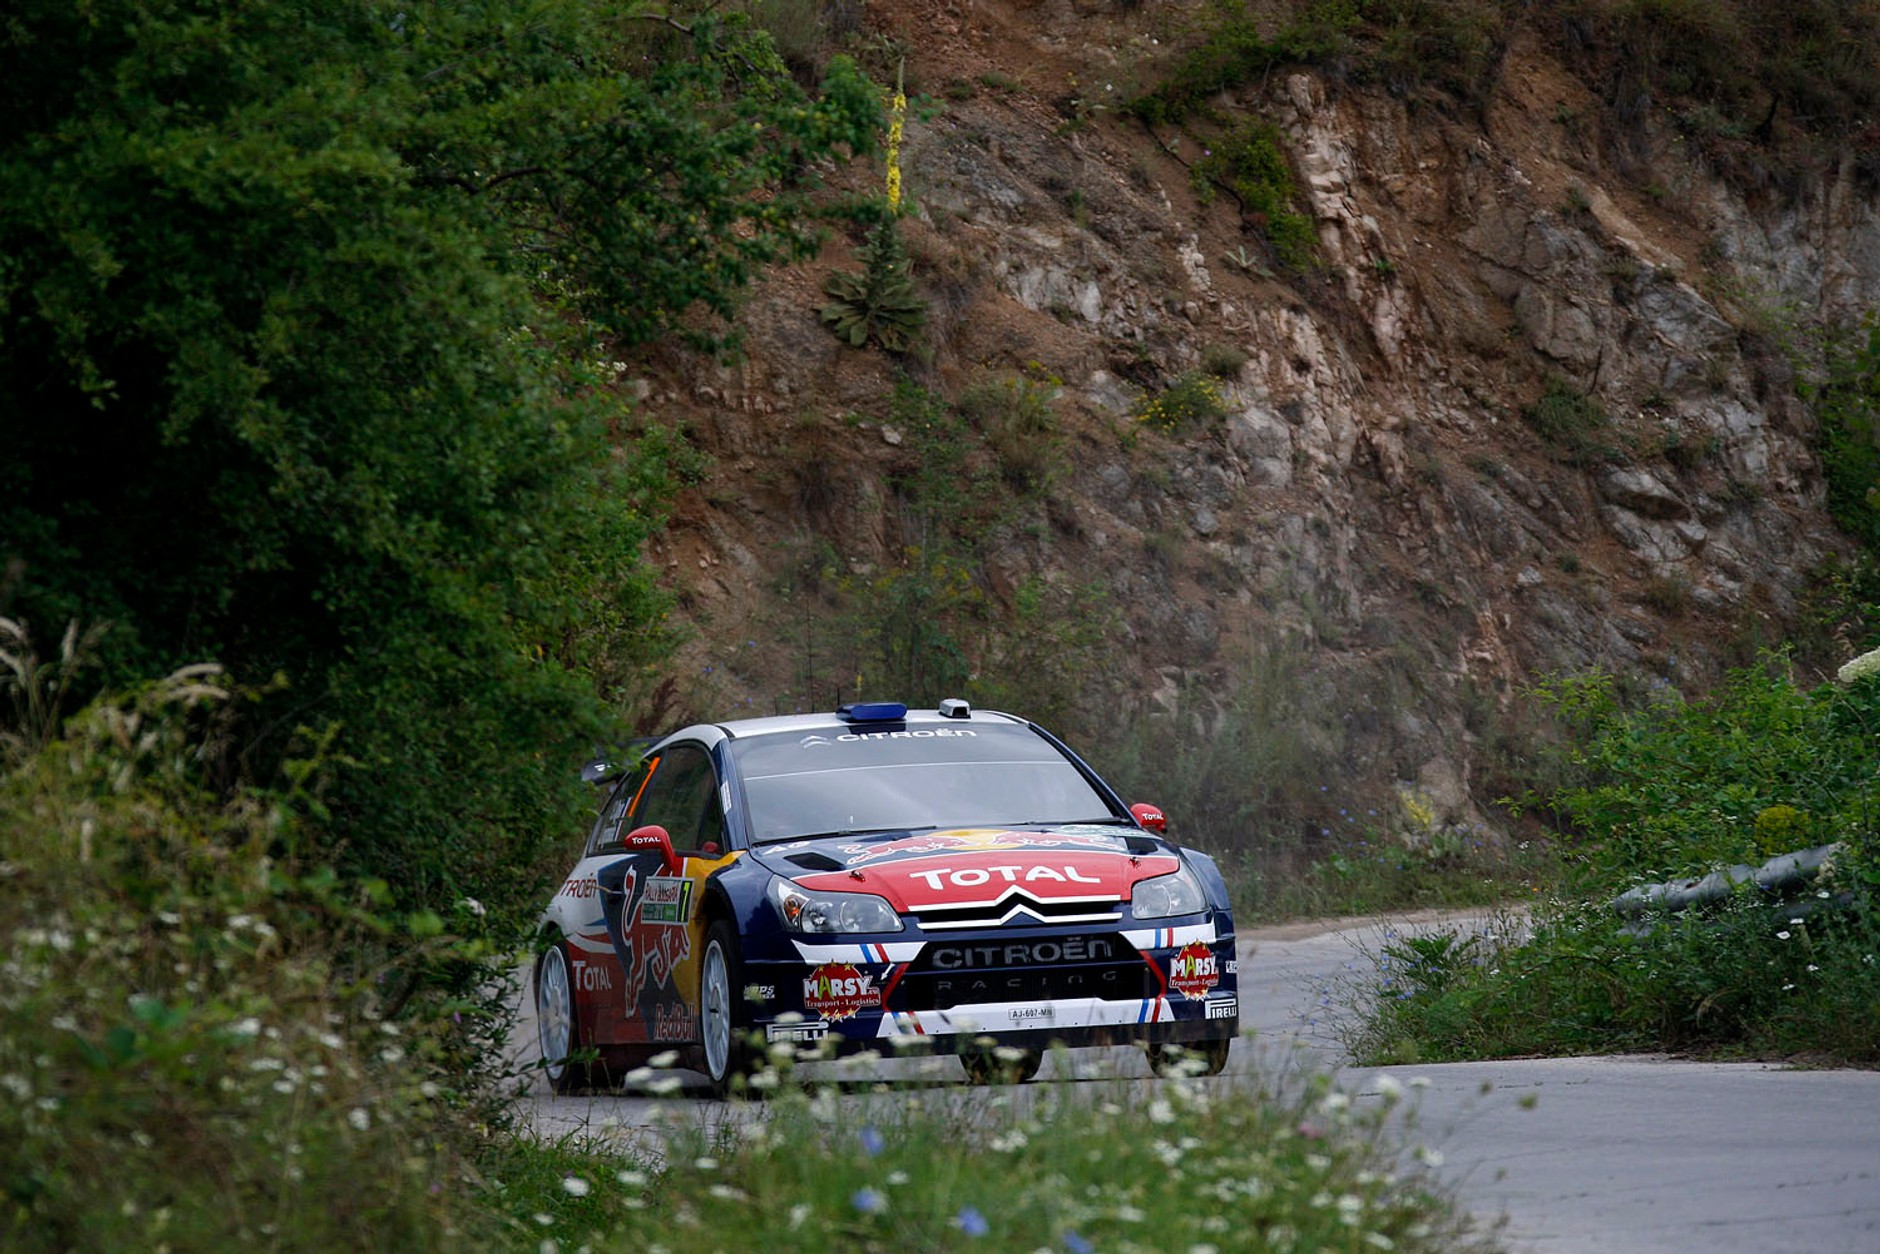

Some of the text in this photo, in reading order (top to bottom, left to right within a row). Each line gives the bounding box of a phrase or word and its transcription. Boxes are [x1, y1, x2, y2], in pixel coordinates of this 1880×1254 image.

[631, 836, 661, 845] TOTAL
[909, 865, 1101, 890] TOTAL
[572, 960, 612, 991] TOTAL
[1170, 954, 1217, 979] MARSY
[803, 974, 873, 1000] MARSY
[937, 971, 1117, 990] RACING
[1205, 998, 1237, 1020] PIRELLI
